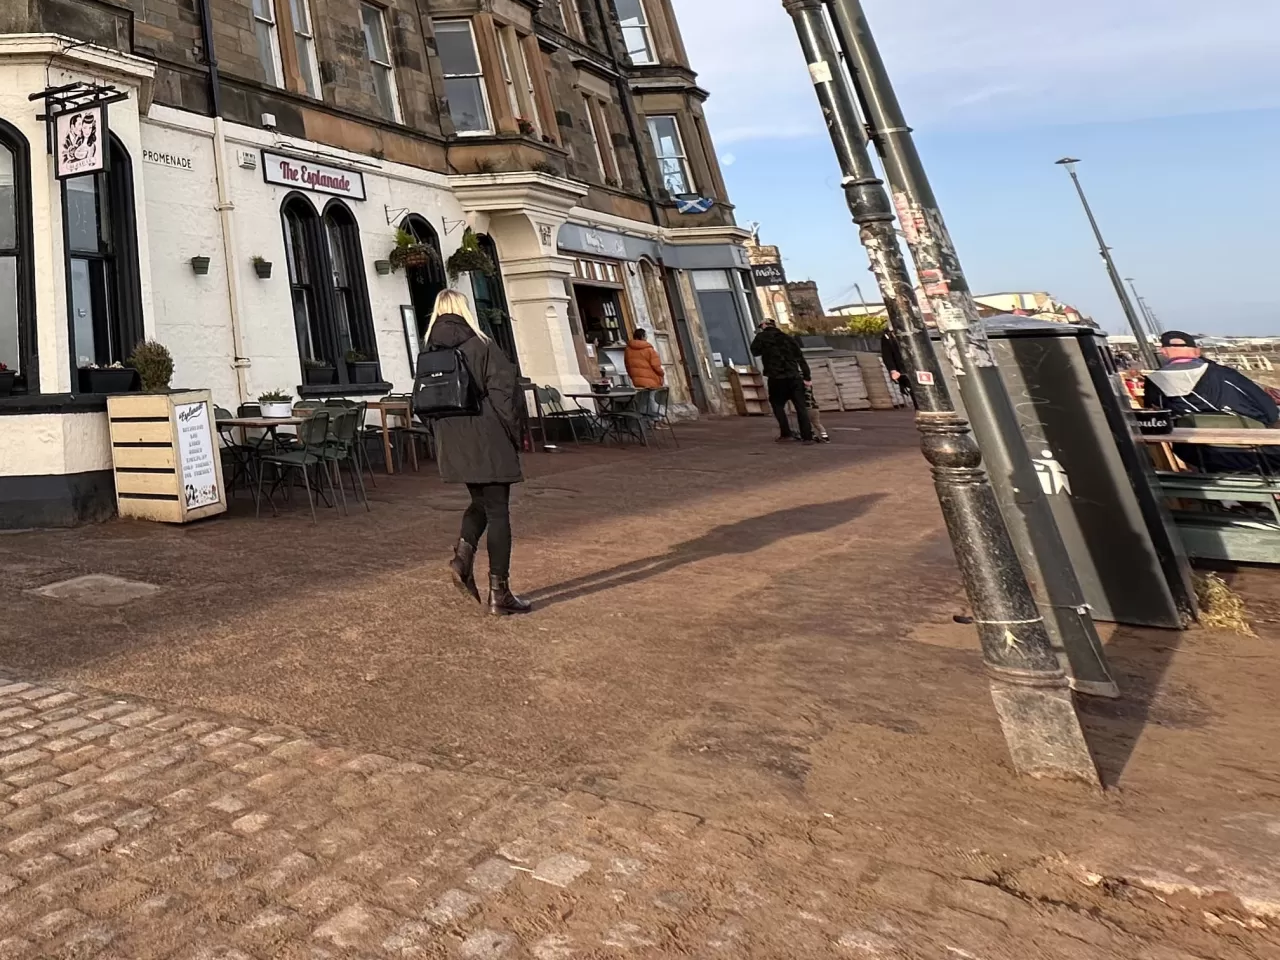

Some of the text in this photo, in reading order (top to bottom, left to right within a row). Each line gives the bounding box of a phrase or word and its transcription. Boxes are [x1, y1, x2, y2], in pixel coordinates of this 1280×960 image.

[142, 149, 193, 169] PROMENADE
[279, 160, 351, 192] The Esplanade
